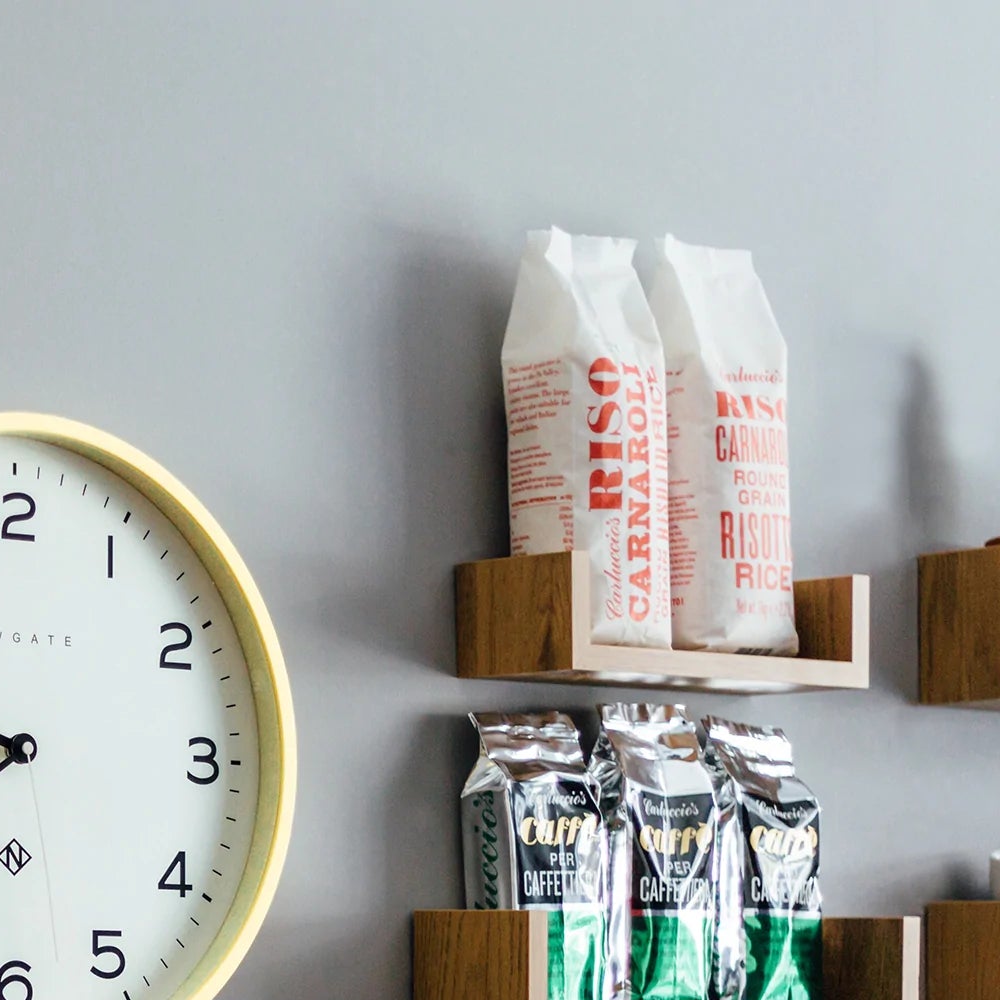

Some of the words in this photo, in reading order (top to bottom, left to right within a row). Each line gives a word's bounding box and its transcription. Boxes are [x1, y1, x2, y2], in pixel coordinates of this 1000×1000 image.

[586, 357, 624, 512] RISO
[620, 362, 652, 622] CARNAROLI
[107, 535, 114, 579] 1
[735, 562, 792, 592] RICE
[159, 622, 193, 671] 2
[186, 736, 220, 785] 3
[157, 851, 193, 898] 4
[549, 852, 575, 866] PER
[666, 860, 692, 875] PER
[90, 929, 126, 980] 5
